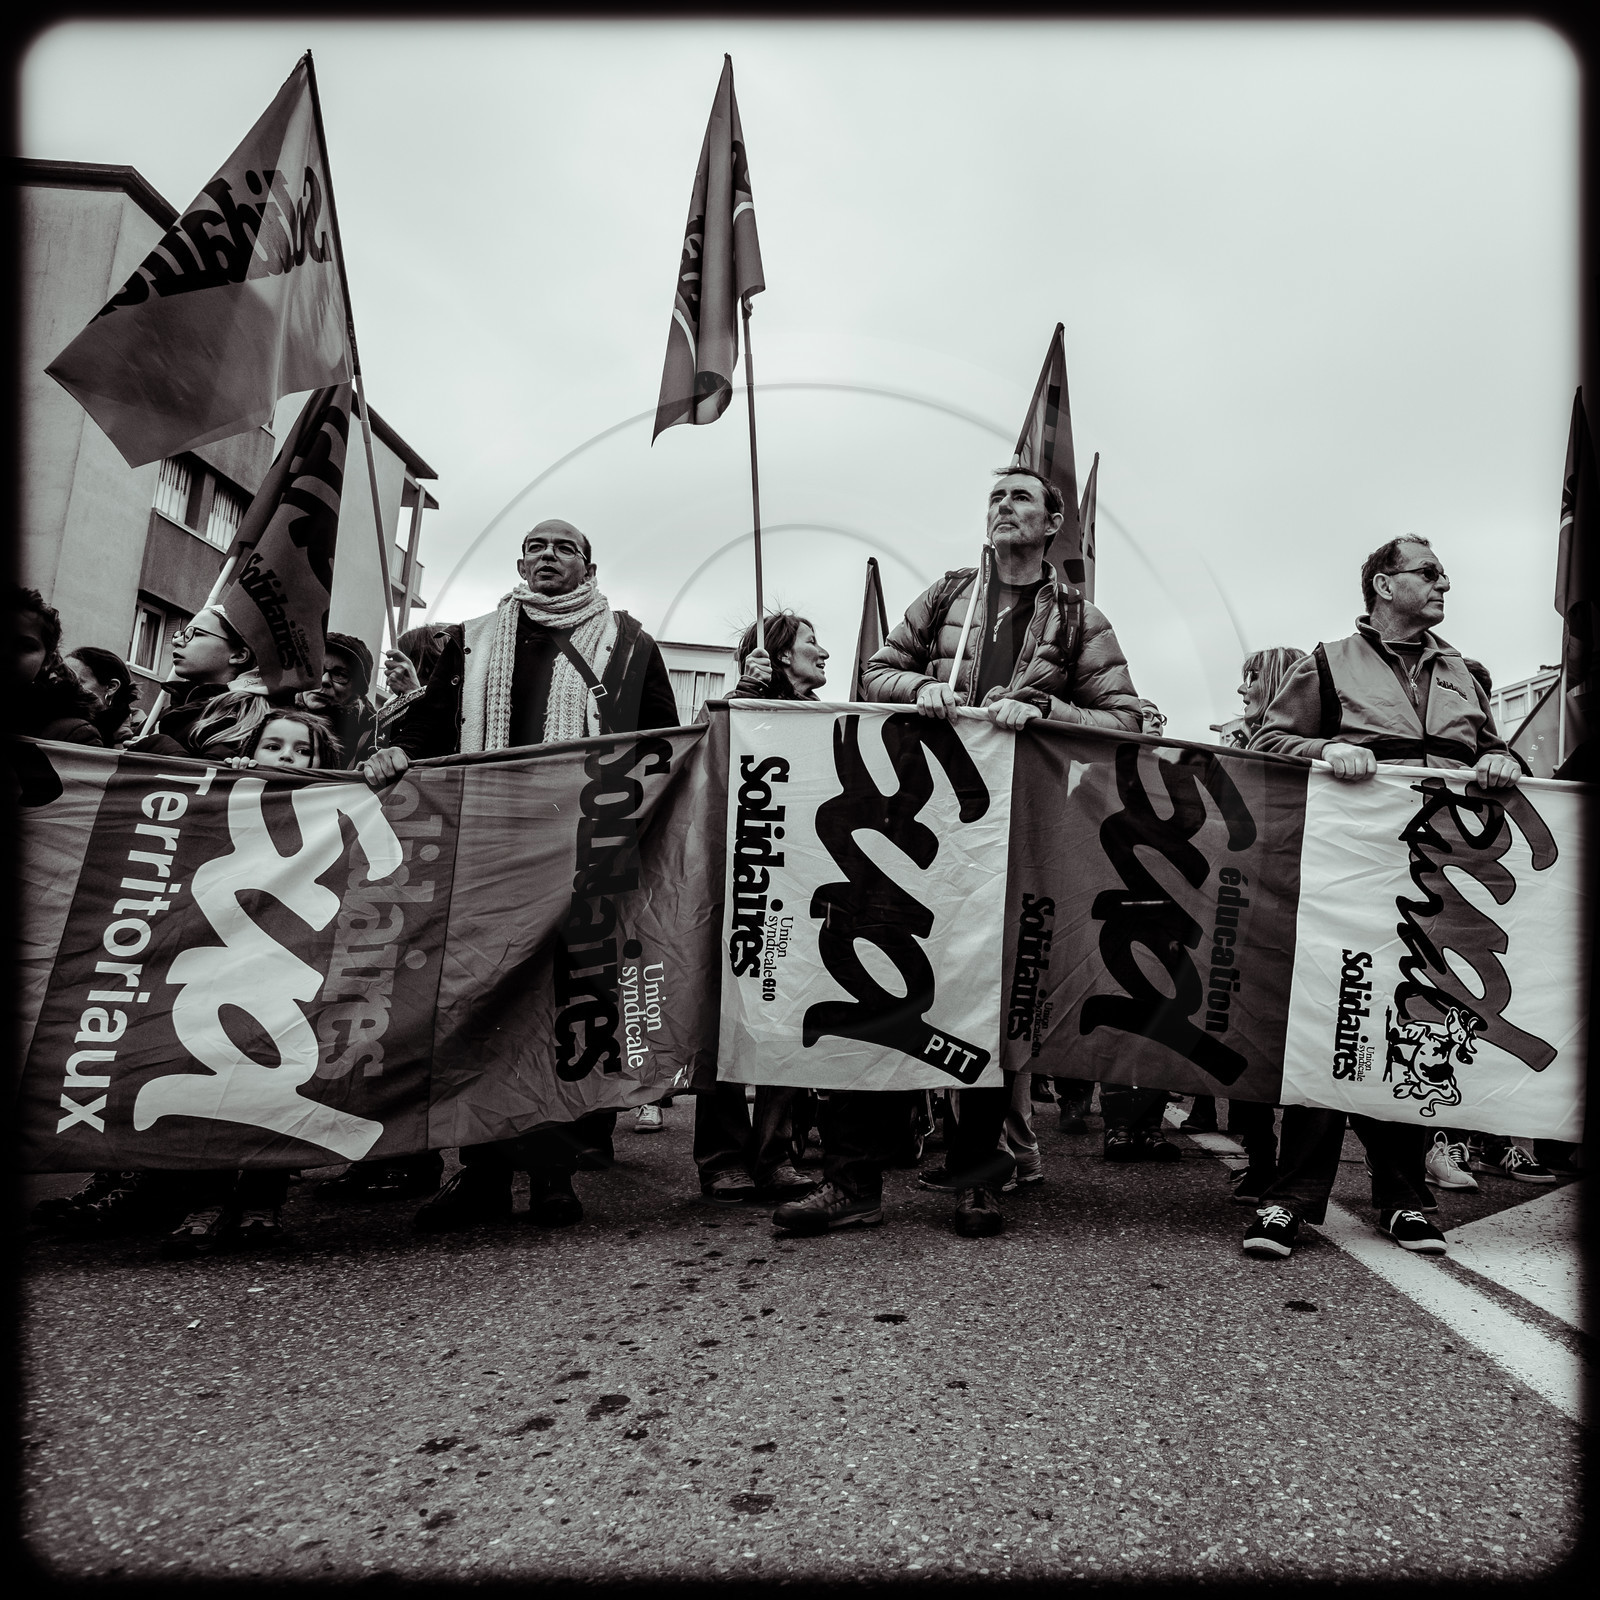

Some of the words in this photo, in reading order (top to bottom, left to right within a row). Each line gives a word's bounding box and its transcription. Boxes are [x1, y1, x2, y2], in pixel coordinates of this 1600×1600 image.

[729, 755, 790, 978] Solidaires
[56, 767, 218, 1134] Territoriaux
[764, 915, 780, 978] syndicale
[778, 915, 794, 958] Union
[1006, 893, 1055, 1042] Solidaires
[1205, 866, 1250, 1033] éducation
[616, 965, 649, 1069] syndicale
[643, 961, 664, 1032] Union
[1332, 949, 1373, 1081] Solidaires
[923, 1034, 978, 1074] PTT
[1356, 1045, 1367, 1082] syndicale
[1364, 1046, 1375, 1071] Union
